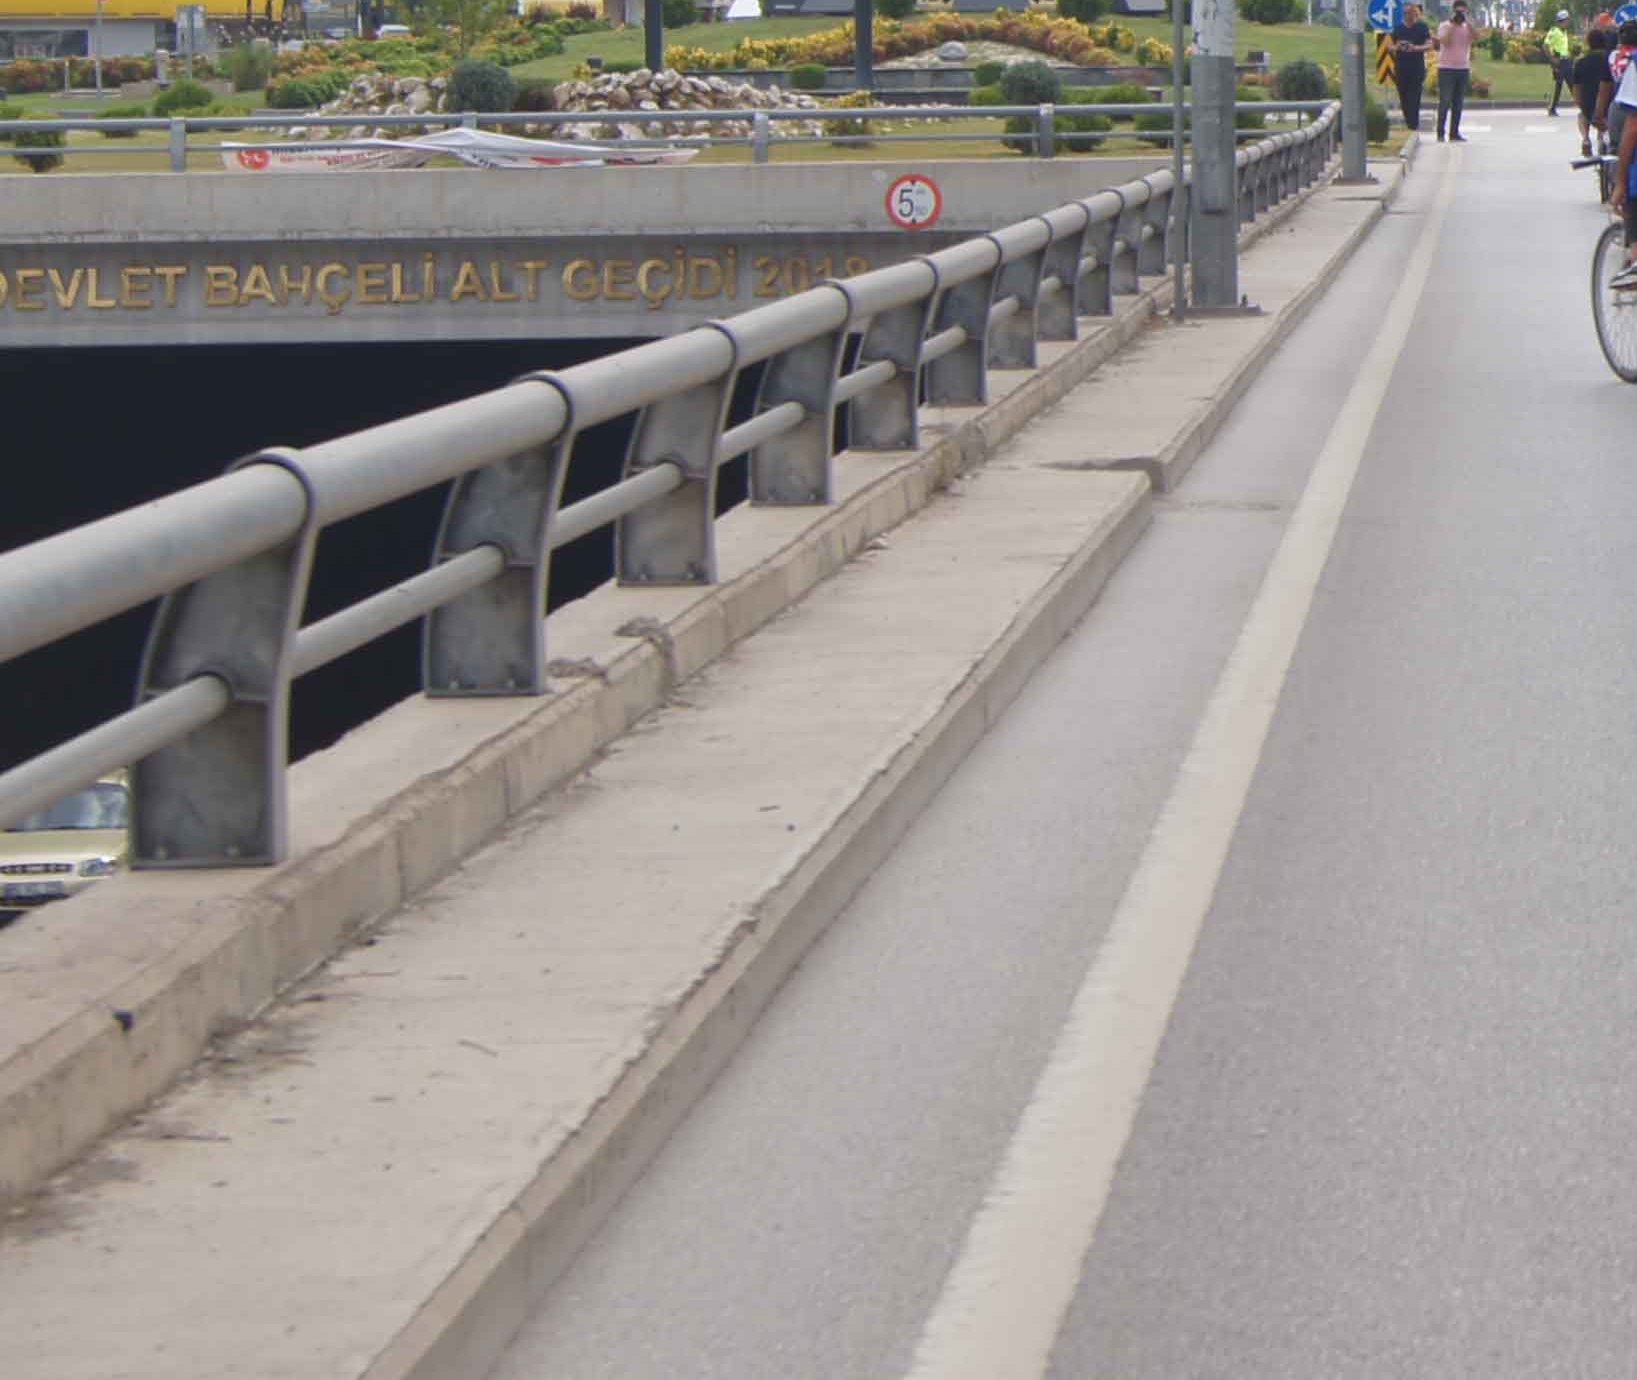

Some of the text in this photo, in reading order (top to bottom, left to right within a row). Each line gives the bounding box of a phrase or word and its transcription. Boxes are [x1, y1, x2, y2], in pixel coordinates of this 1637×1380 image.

[0, 263, 187, 310] EVLET
[205, 252, 435, 317] BAHÇELİ
[449, 259, 552, 302] ALT
[562, 243, 738, 311] GEÇİDİ
